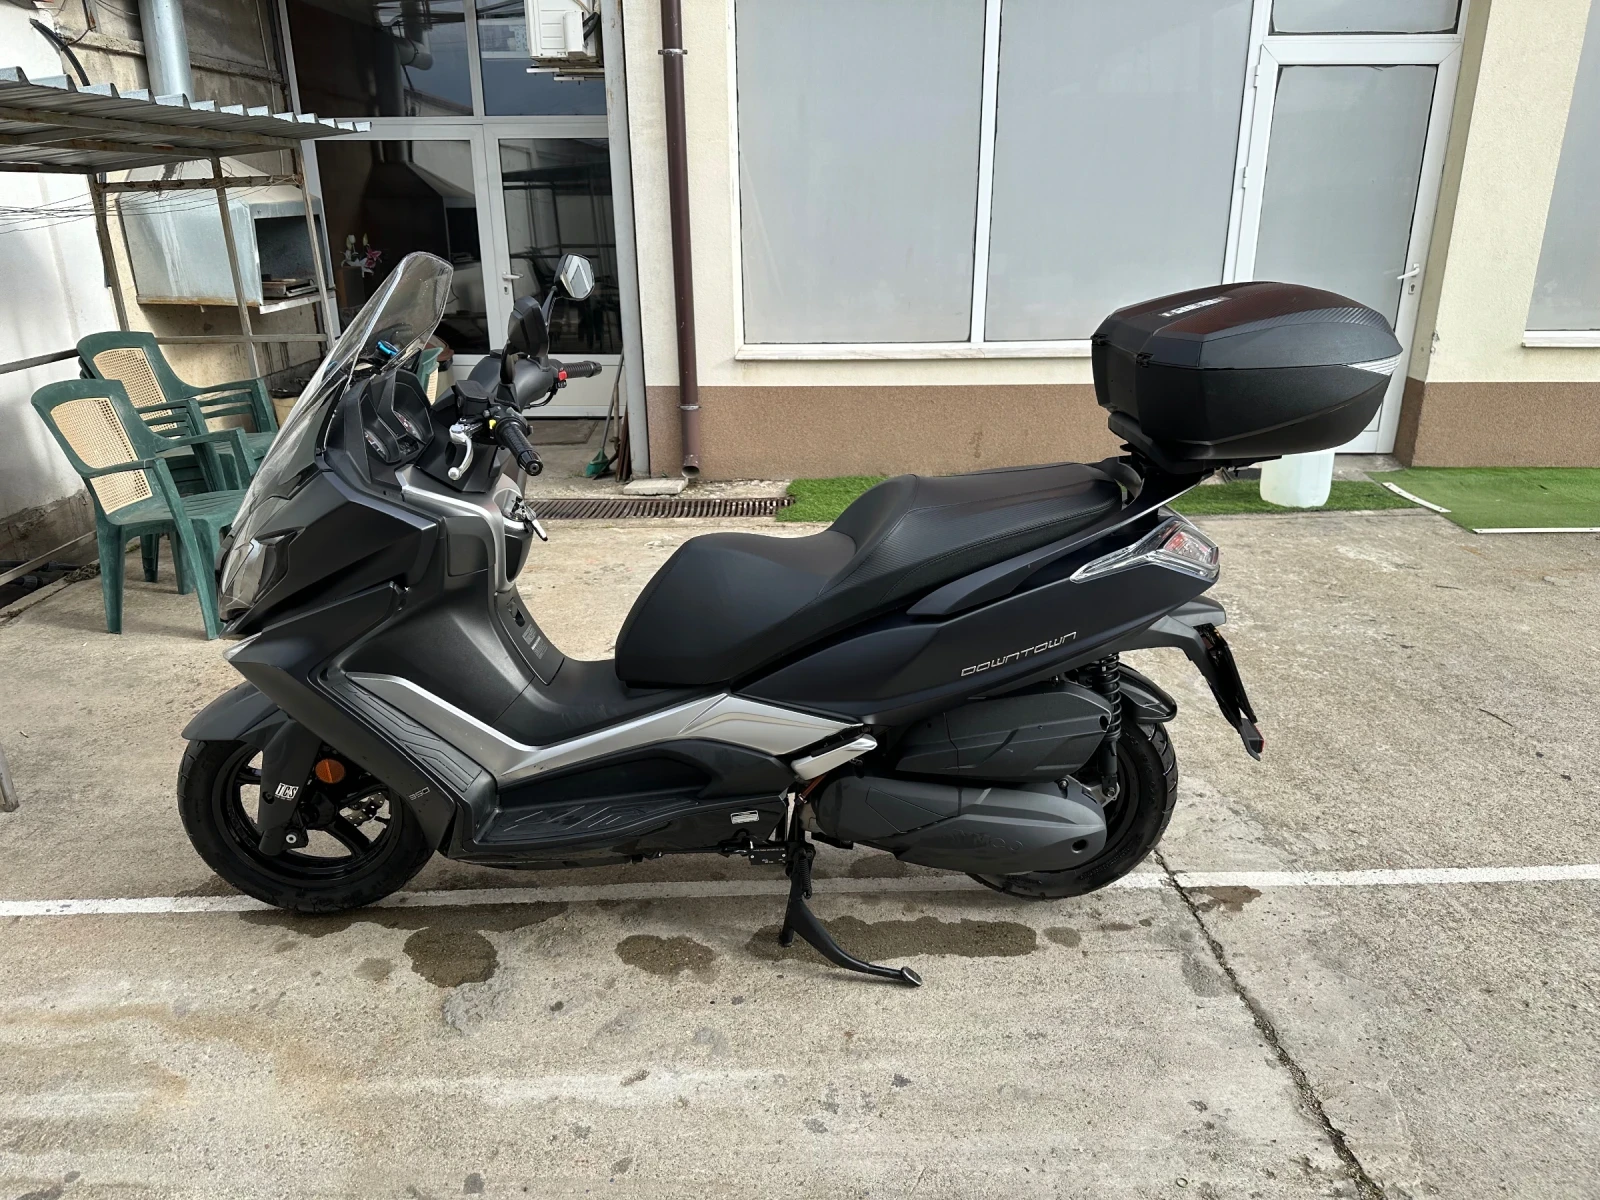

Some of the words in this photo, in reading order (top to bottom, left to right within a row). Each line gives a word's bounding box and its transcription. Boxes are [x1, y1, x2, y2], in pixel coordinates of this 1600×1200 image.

[961, 631, 1077, 677] DOWNTOWN
[277, 783, 298, 798] TCS
[408, 786, 431, 801] 350
